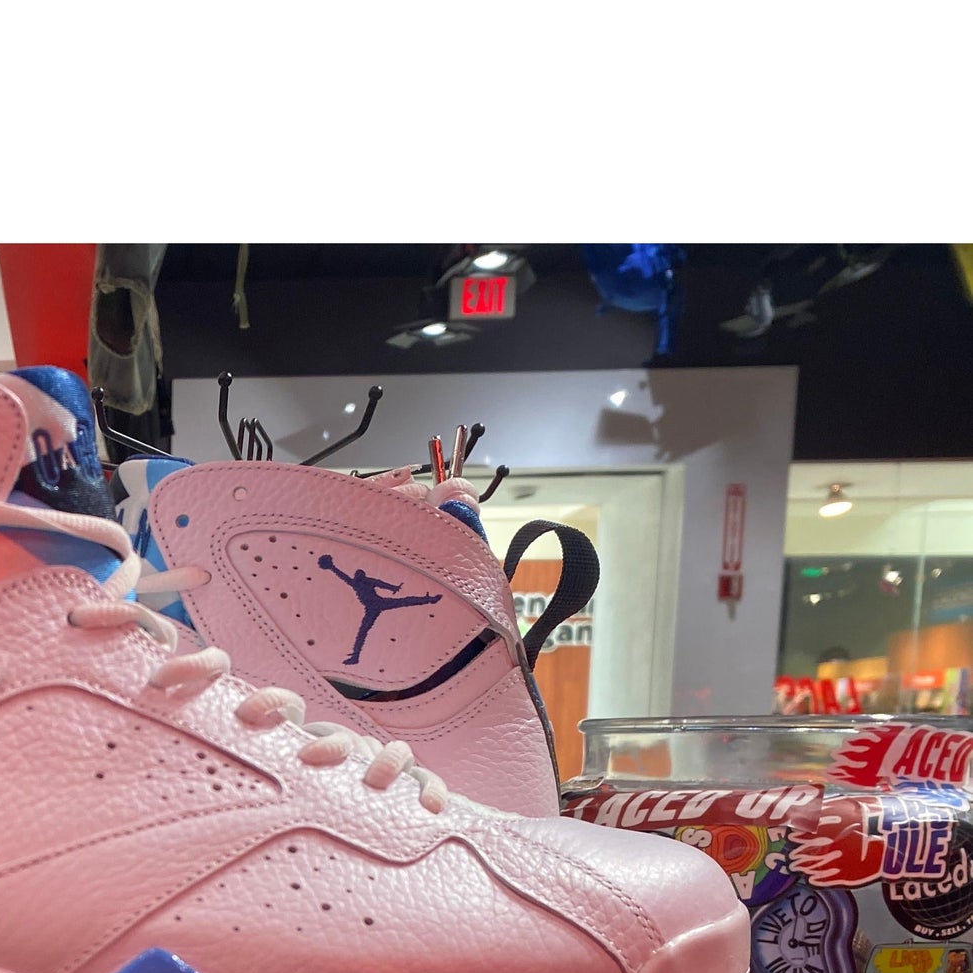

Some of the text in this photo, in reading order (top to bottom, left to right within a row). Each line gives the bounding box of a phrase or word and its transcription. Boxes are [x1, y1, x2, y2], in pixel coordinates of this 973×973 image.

[460, 276, 508, 315] EXIT
[735, 784, 821, 819] UP
[756, 891, 827, 958] LIVE TO DIE
[914, 924, 935, 936] BUY
[941, 925, 961, 937] SELL
